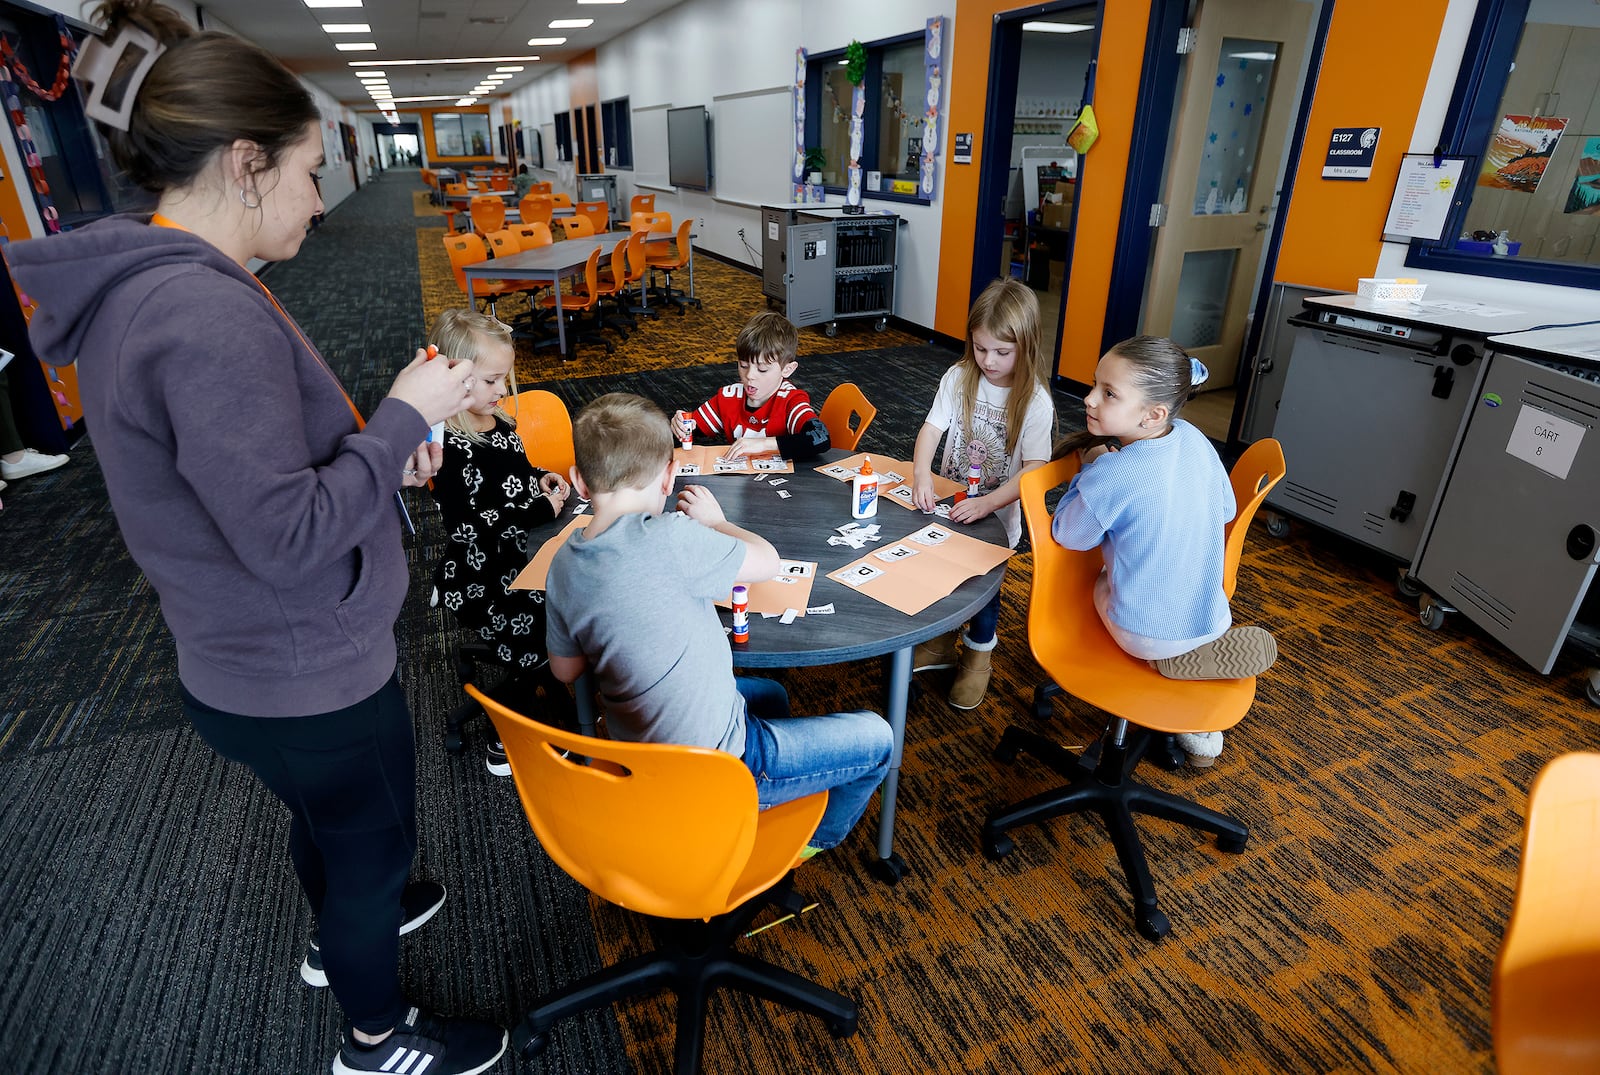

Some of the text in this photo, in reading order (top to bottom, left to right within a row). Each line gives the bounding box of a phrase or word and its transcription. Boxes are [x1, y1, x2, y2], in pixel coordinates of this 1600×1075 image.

[1332, 133, 1353, 142] E127
[1534, 425, 1560, 442] CART
[1535, 446, 1543, 456] 8
